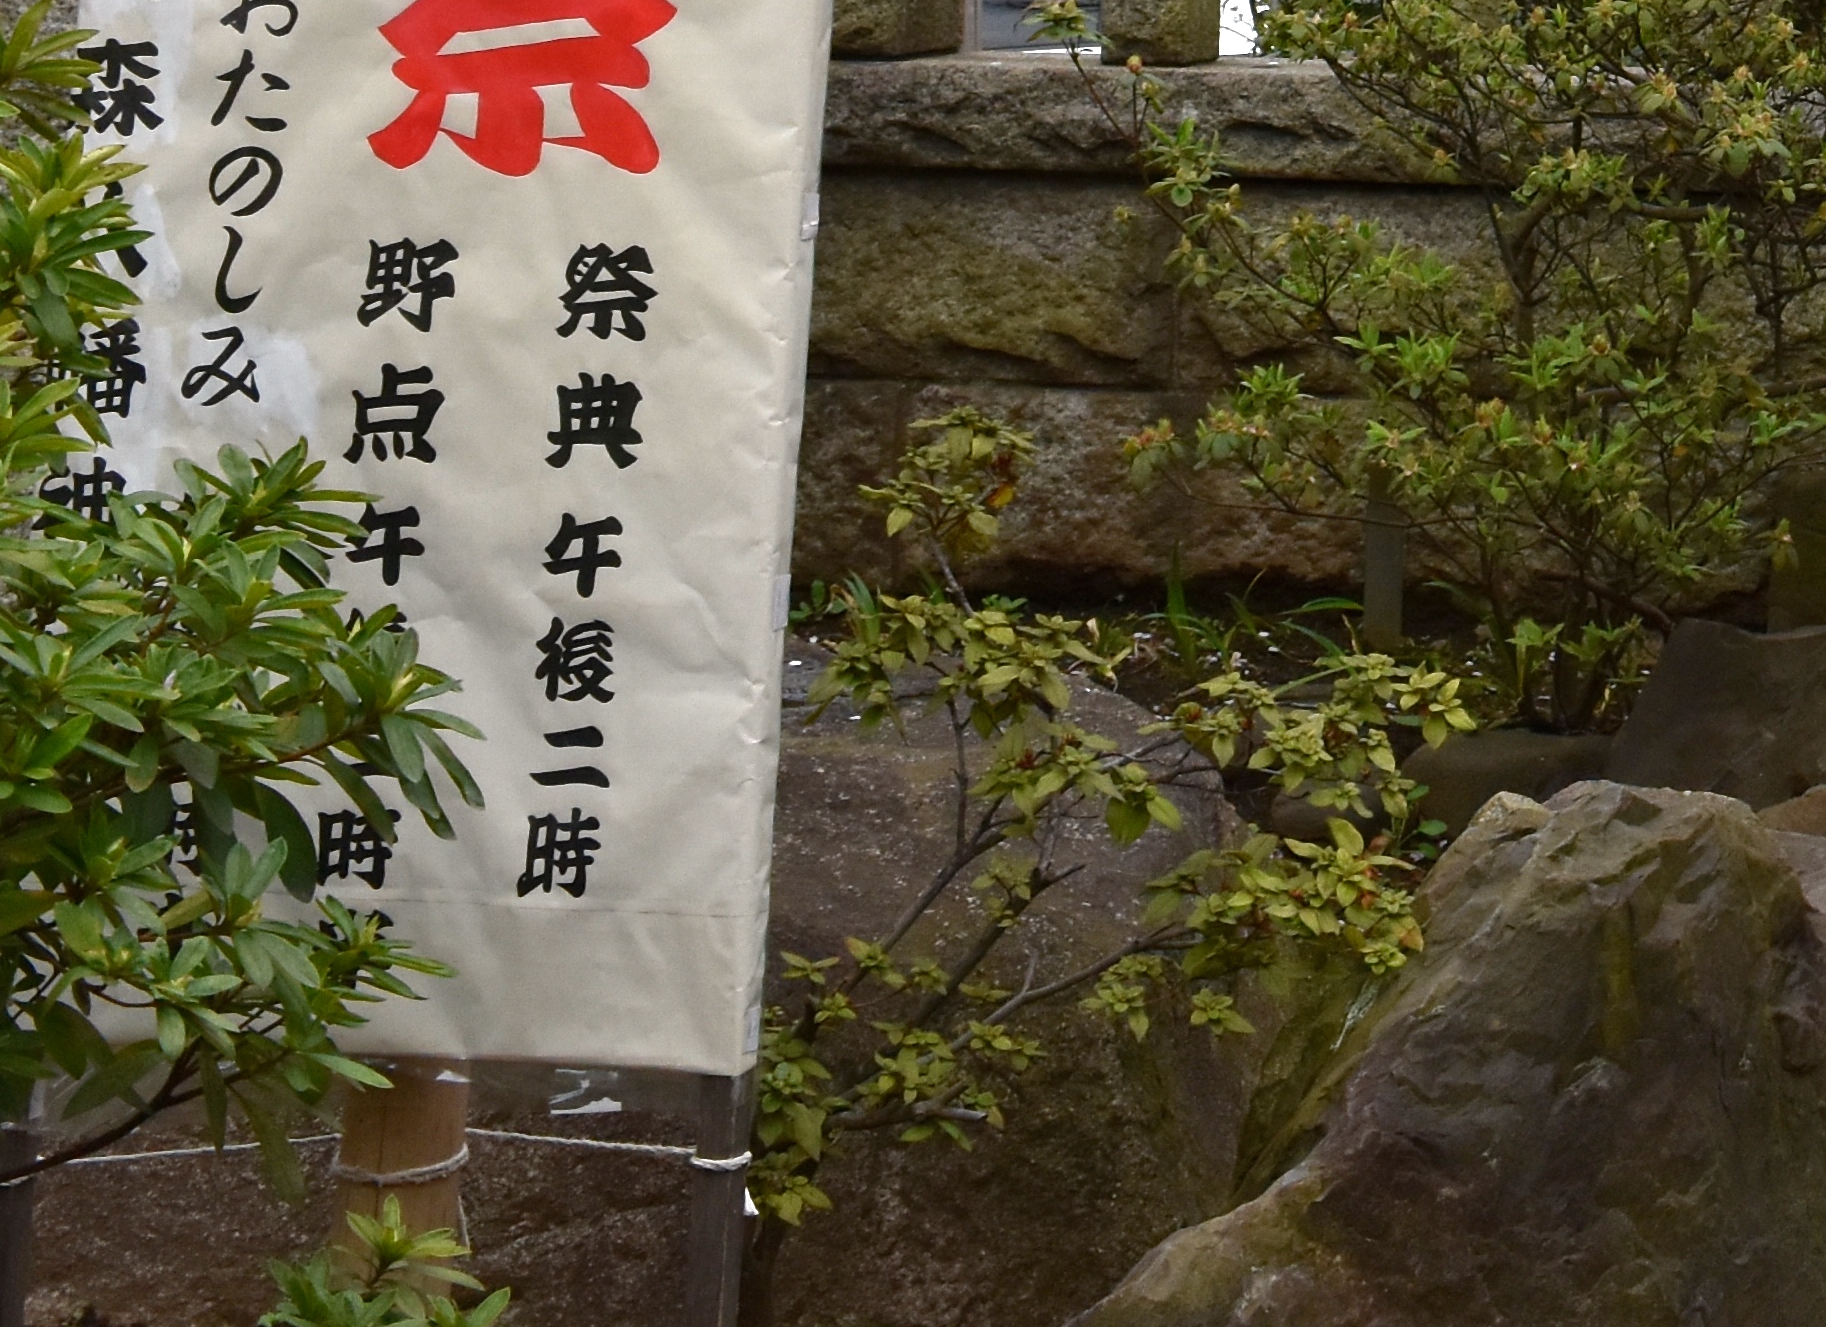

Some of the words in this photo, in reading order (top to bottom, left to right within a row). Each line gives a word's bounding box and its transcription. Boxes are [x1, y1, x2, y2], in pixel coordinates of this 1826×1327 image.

[515, 242, 659, 899] 祭典午後二時
